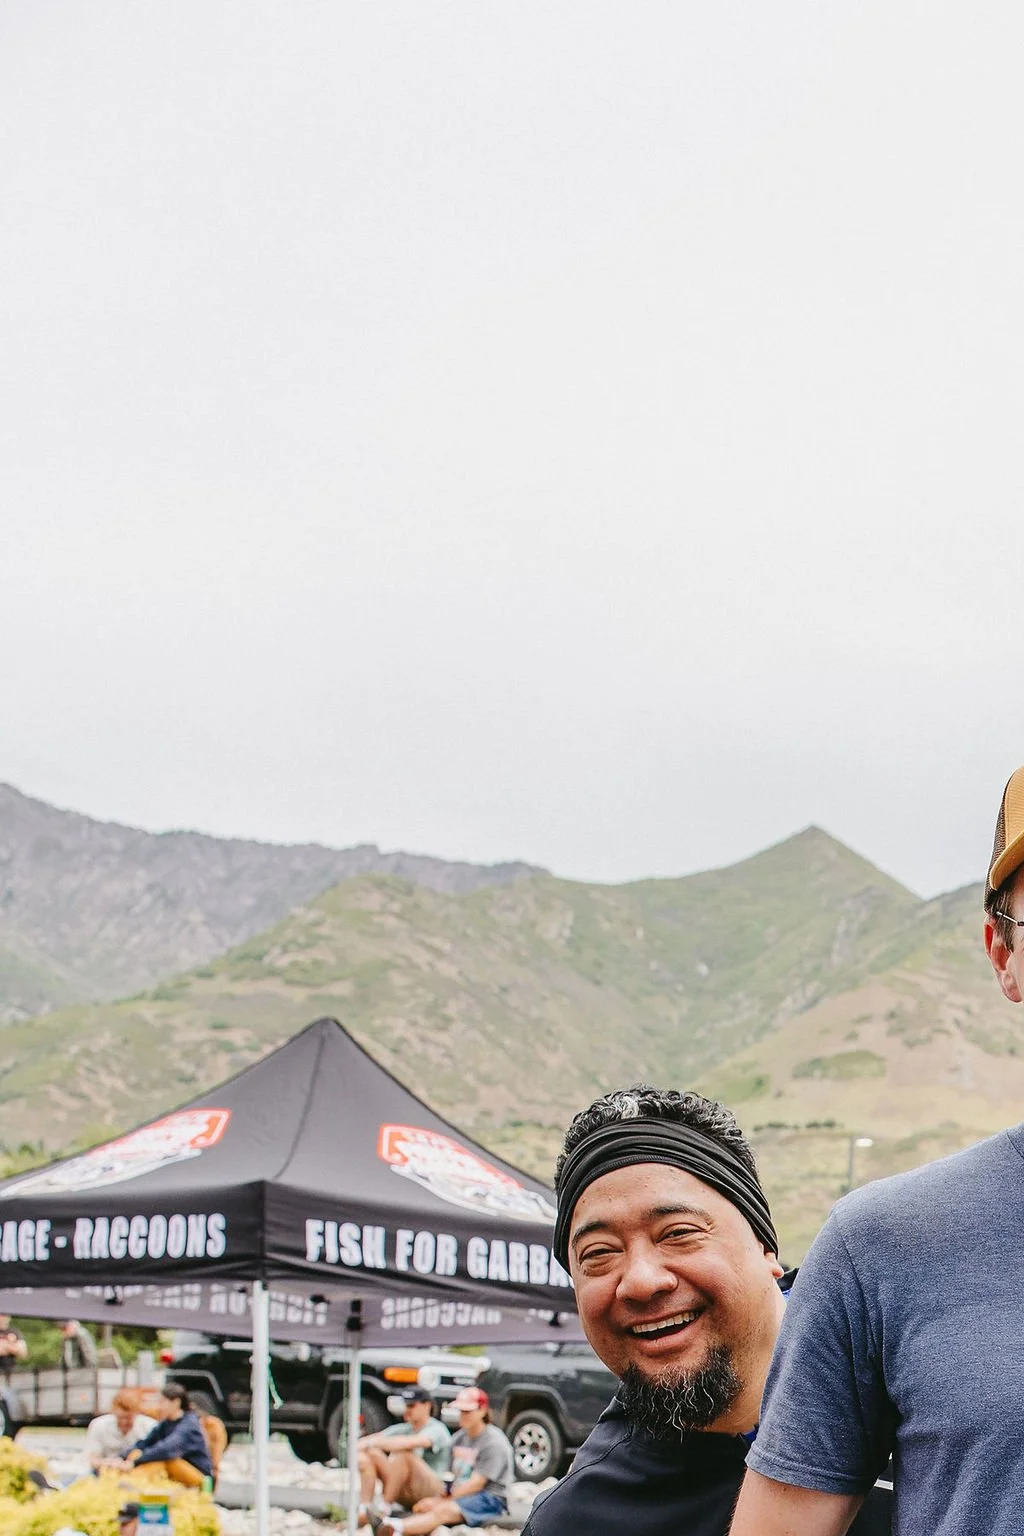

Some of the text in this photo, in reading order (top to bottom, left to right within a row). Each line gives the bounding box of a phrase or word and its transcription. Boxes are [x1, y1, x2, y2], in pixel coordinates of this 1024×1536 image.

[0, 1220, 50, 1262] AGE
[73, 1212, 227, 1260] RACCOONS
[305, 1218, 574, 1288] FISH FOR GARBA
